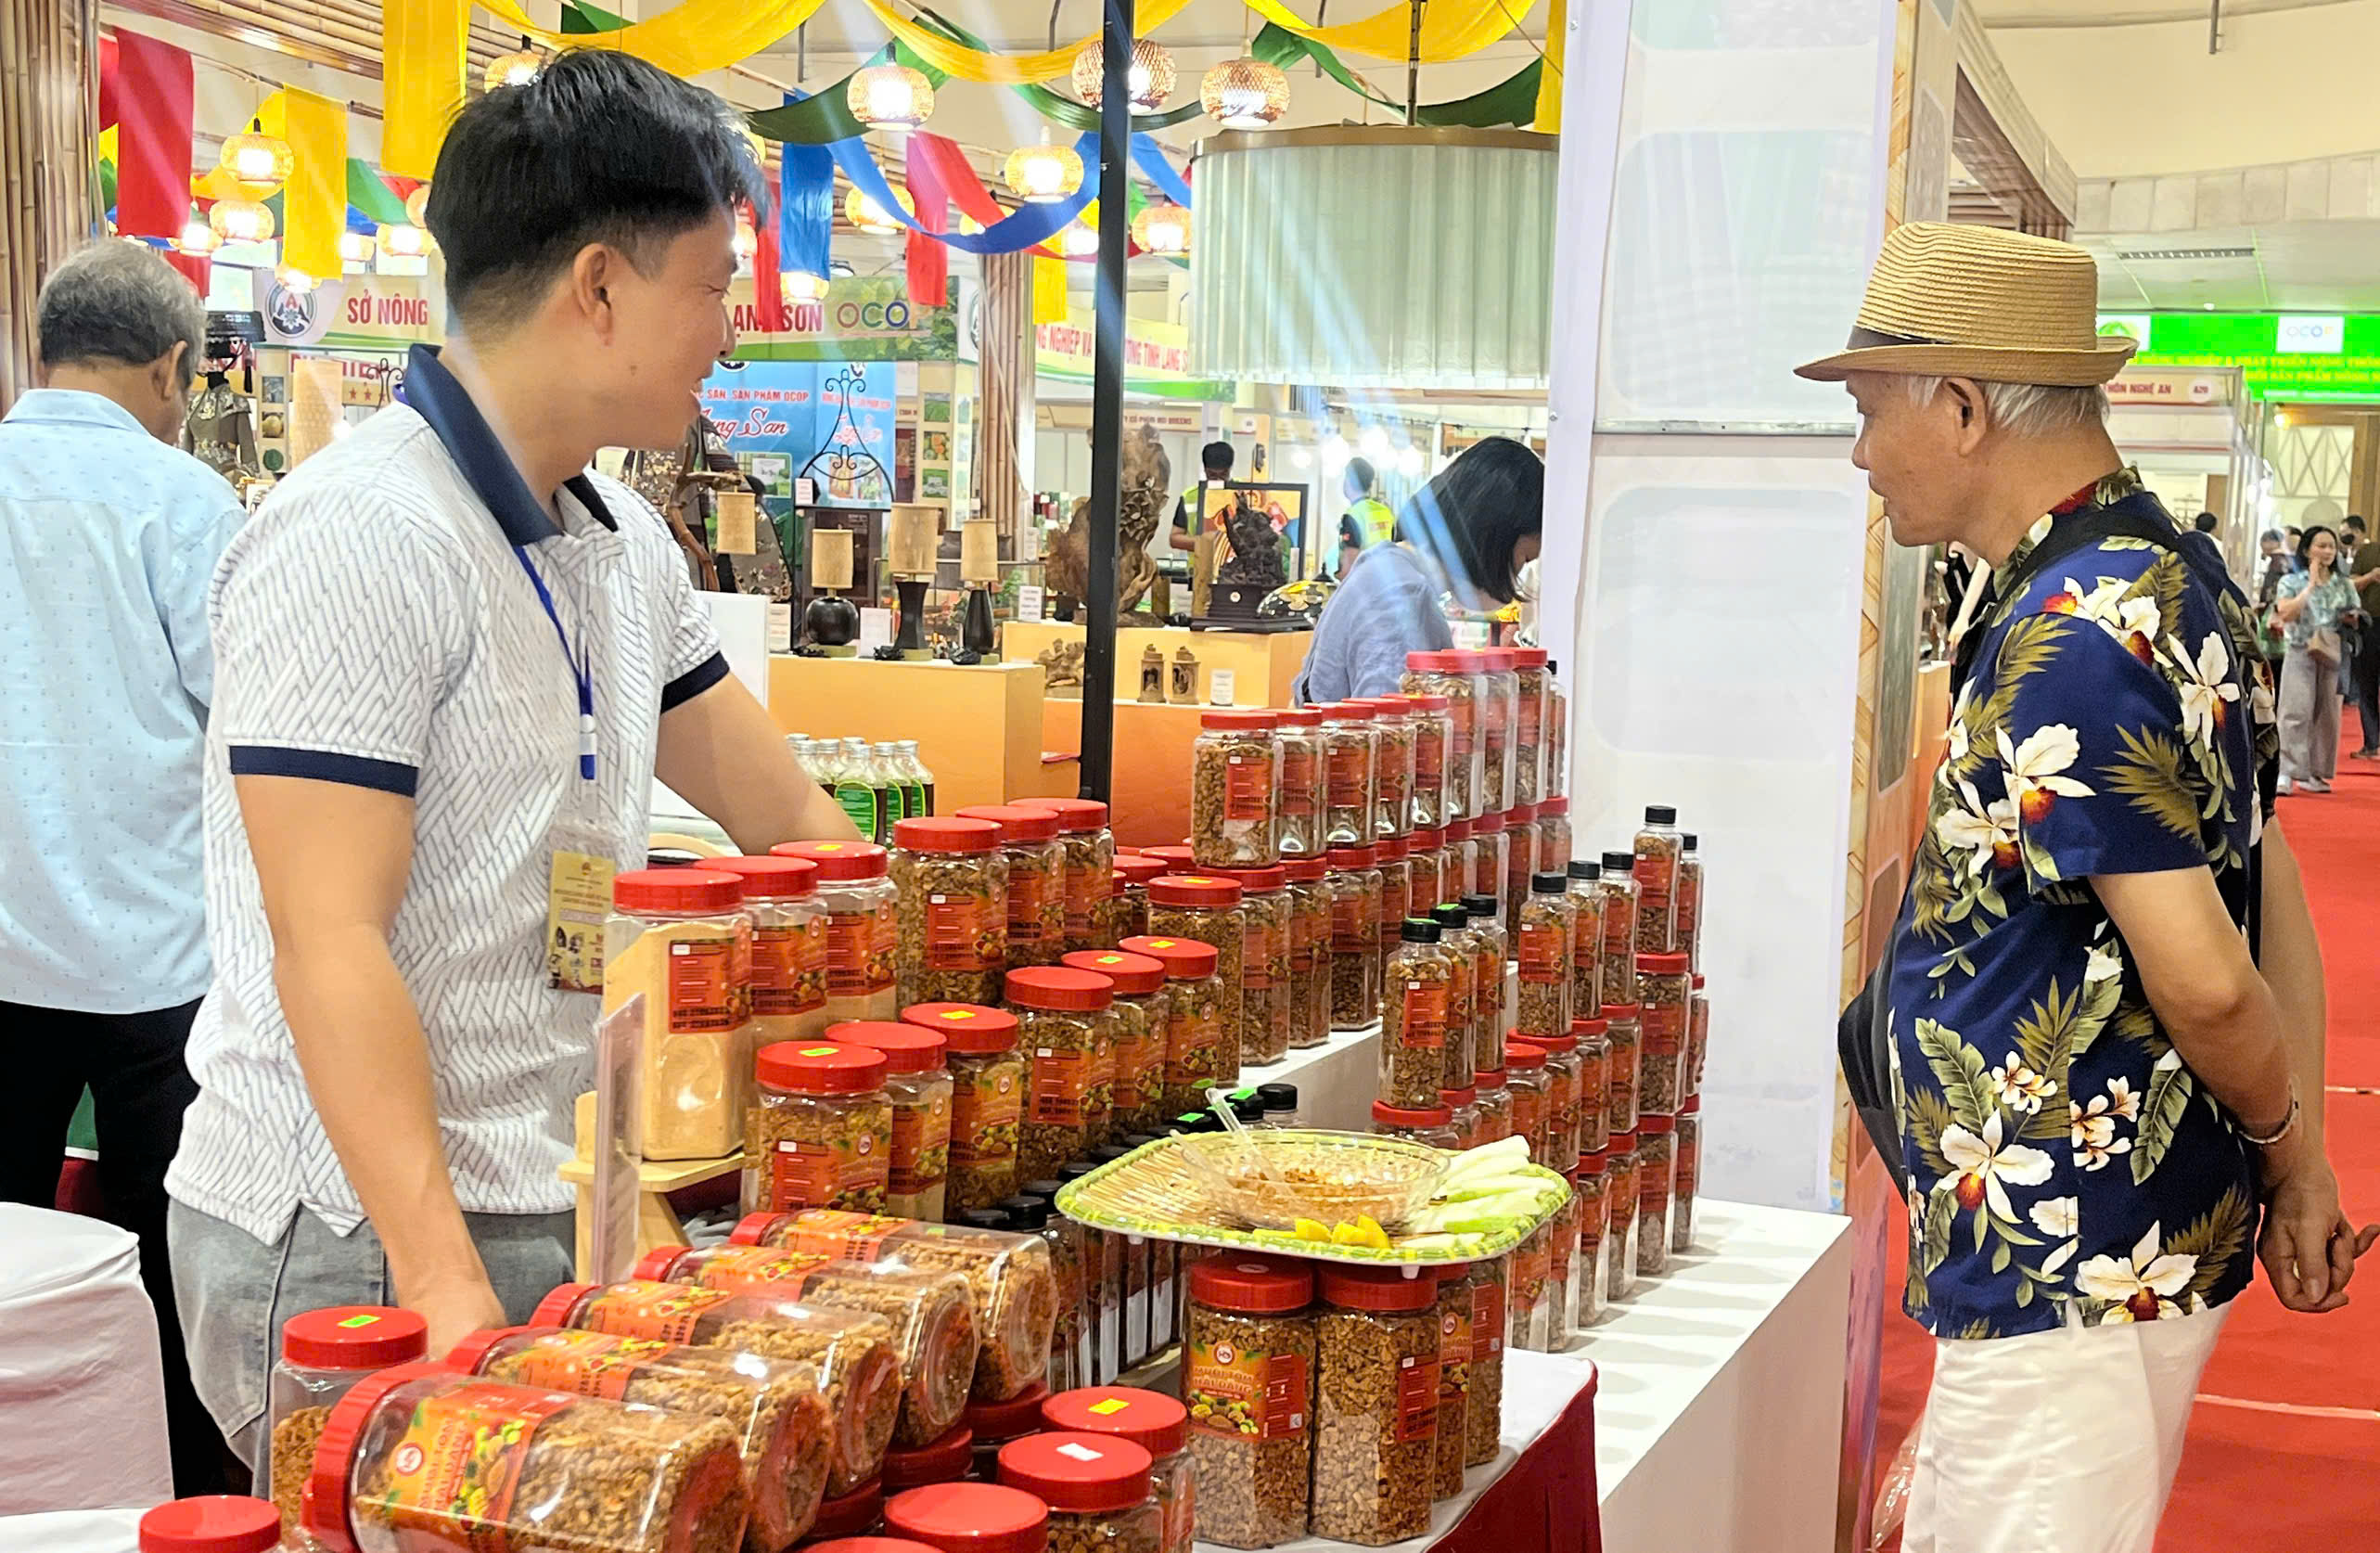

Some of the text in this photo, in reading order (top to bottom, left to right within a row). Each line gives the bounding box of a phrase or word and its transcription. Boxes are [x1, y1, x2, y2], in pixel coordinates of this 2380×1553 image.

[347, 289, 429, 325] SỞ NÔNG
[734, 304, 760, 338] ẠN
[785, 391, 809, 402] OCOP
[2105, 380, 2127, 394] HÔN
